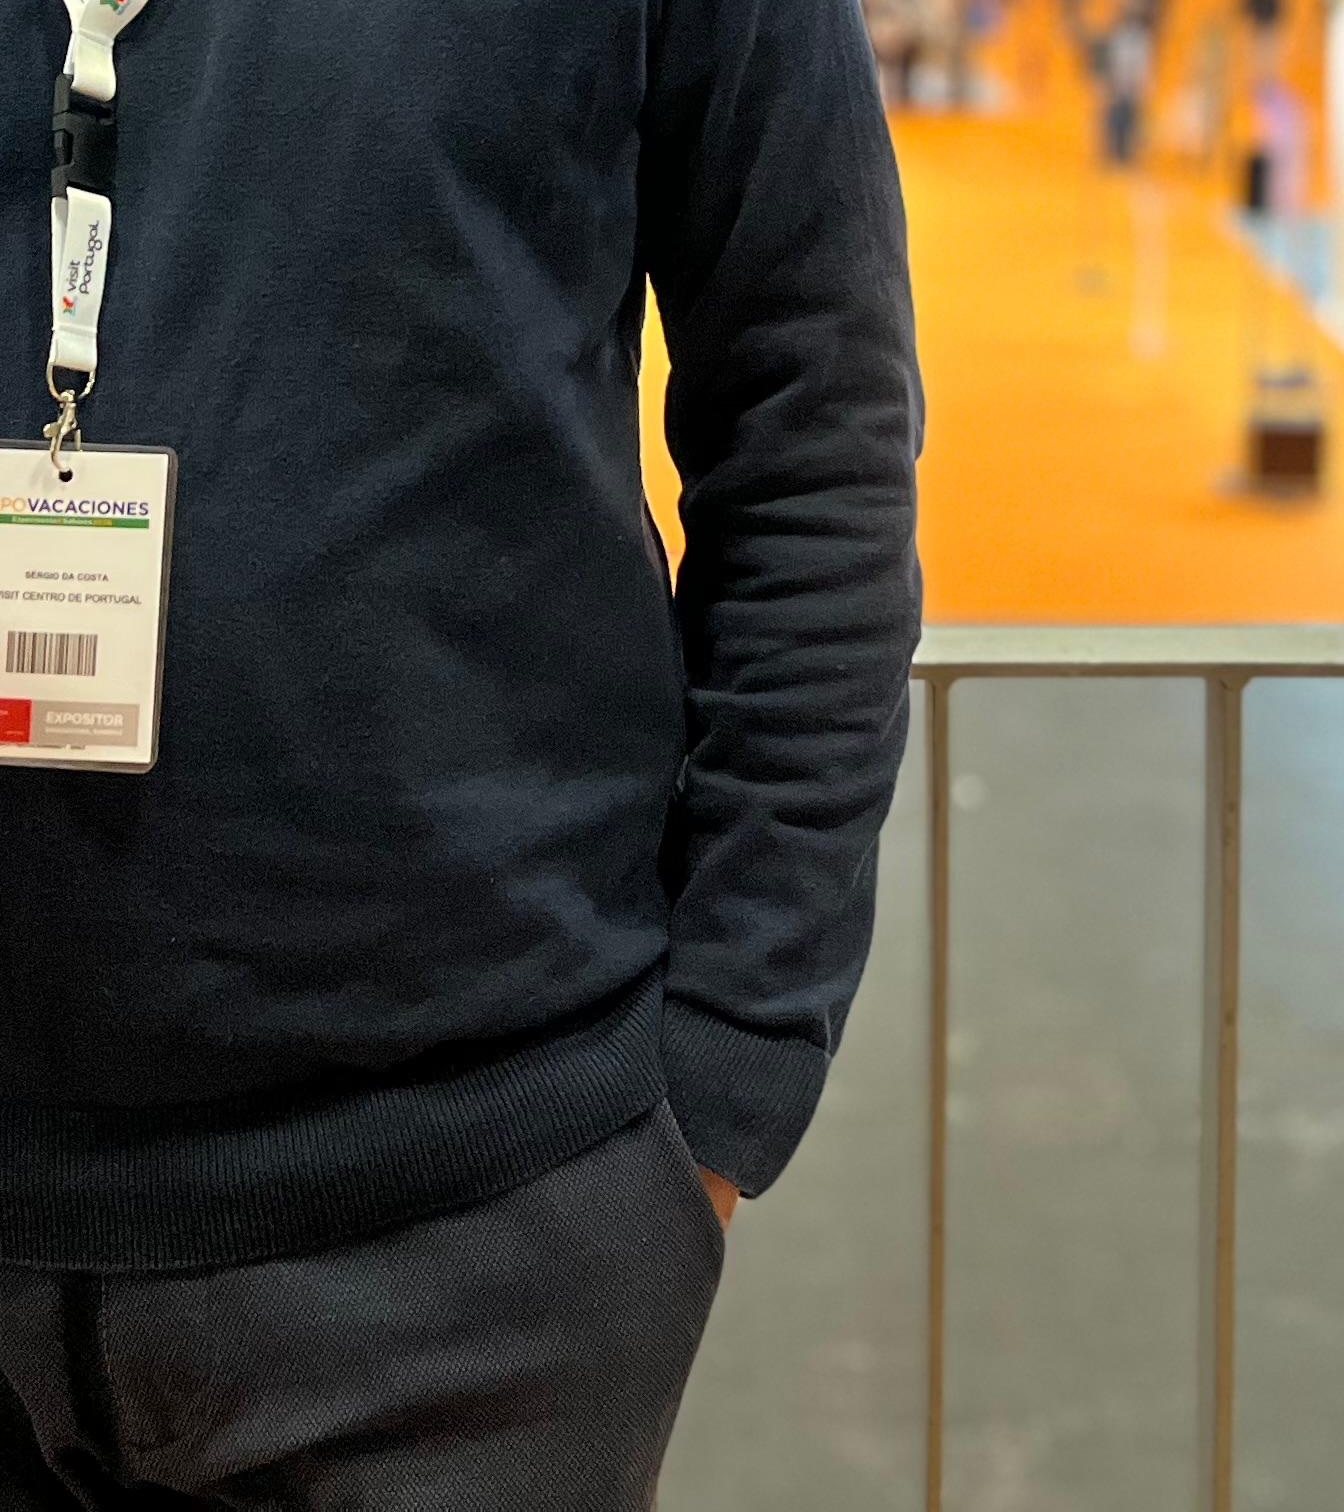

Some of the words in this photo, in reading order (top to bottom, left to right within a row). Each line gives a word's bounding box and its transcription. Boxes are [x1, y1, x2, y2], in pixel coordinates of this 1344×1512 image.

[66, 259, 81, 292] visit
[61, 572, 74, 581] DA
[77, 573, 109, 582] COSTA
[22, 591, 66, 602] CENTRO
[67, 593, 82, 603] DE
[84, 594, 142, 605] PORTUGAL
[45, 710, 124, 727] EXPOSITOR
